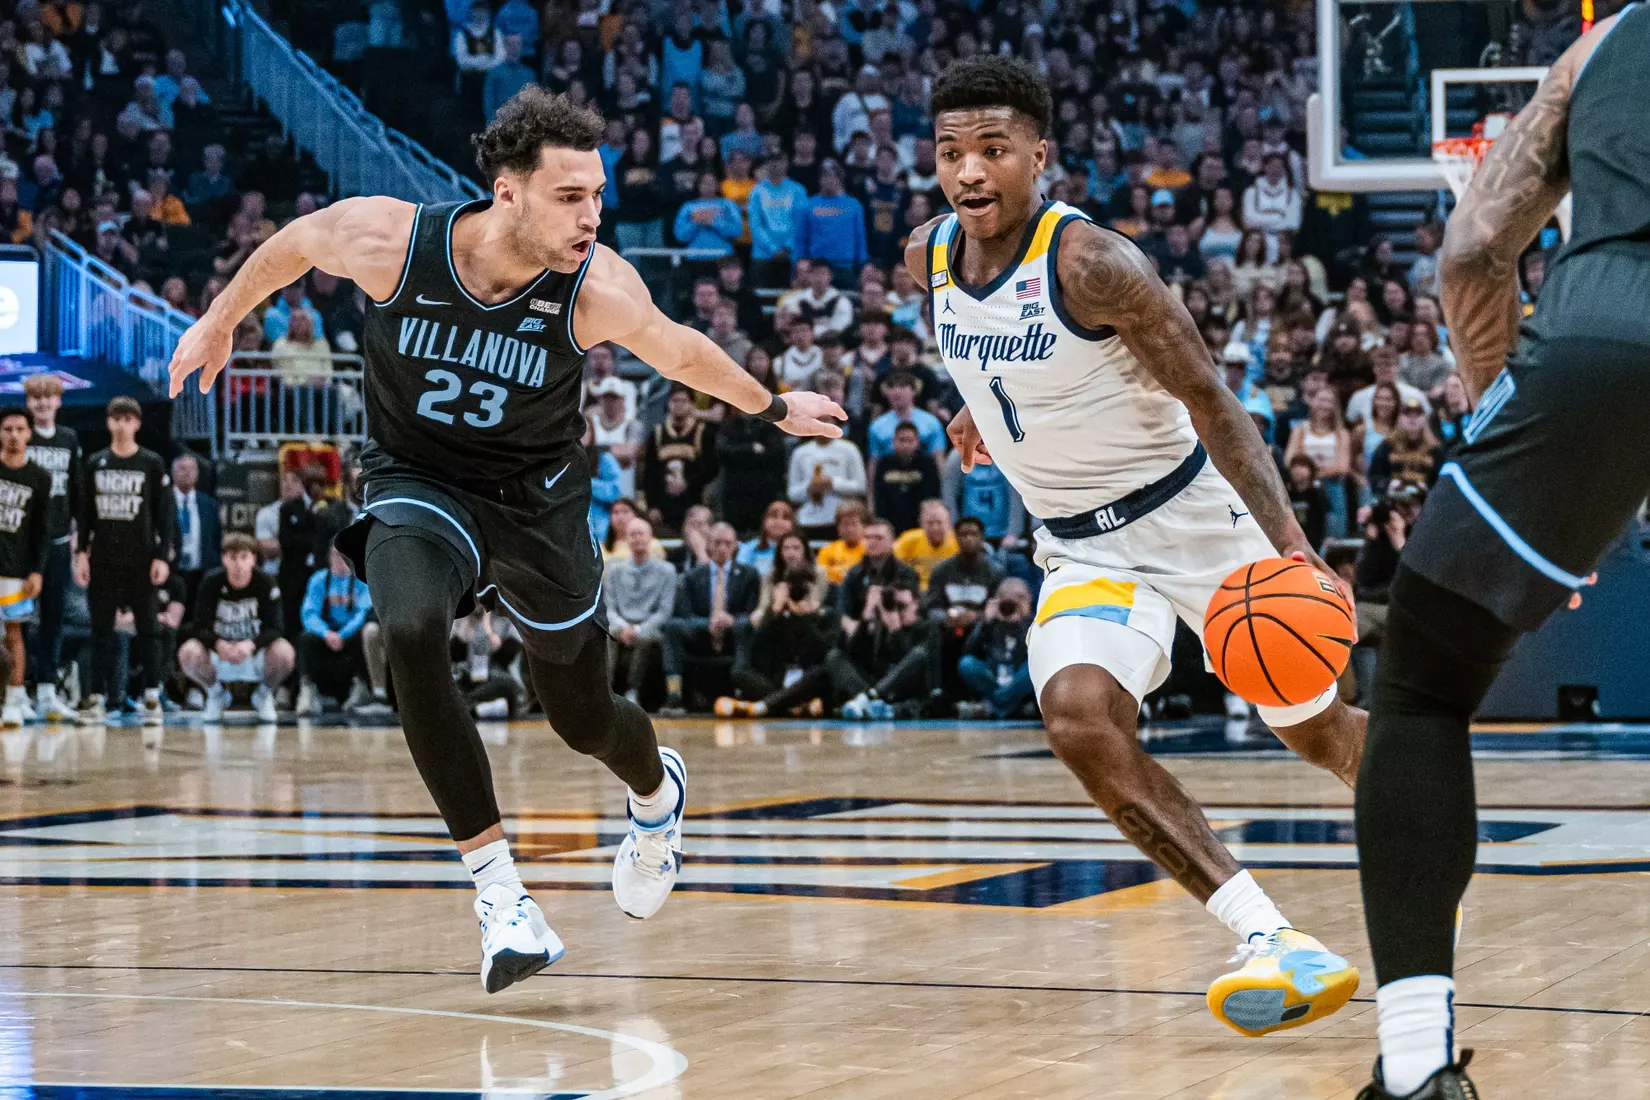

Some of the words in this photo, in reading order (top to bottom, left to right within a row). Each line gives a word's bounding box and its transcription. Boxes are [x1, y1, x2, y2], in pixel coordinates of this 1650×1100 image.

[529, 304, 560, 315] CHANGE
[1020, 307, 1046, 317] EAST
[1022, 302, 1039, 310] BIG
[519, 322, 547, 330] EAST
[398, 317, 548, 388] VILLANOVA
[938, 322, 1058, 371] Marquette
[416, 368, 508, 428] 23
[989, 376, 1026, 442] 1
[1094, 506, 1126, 531] AL
